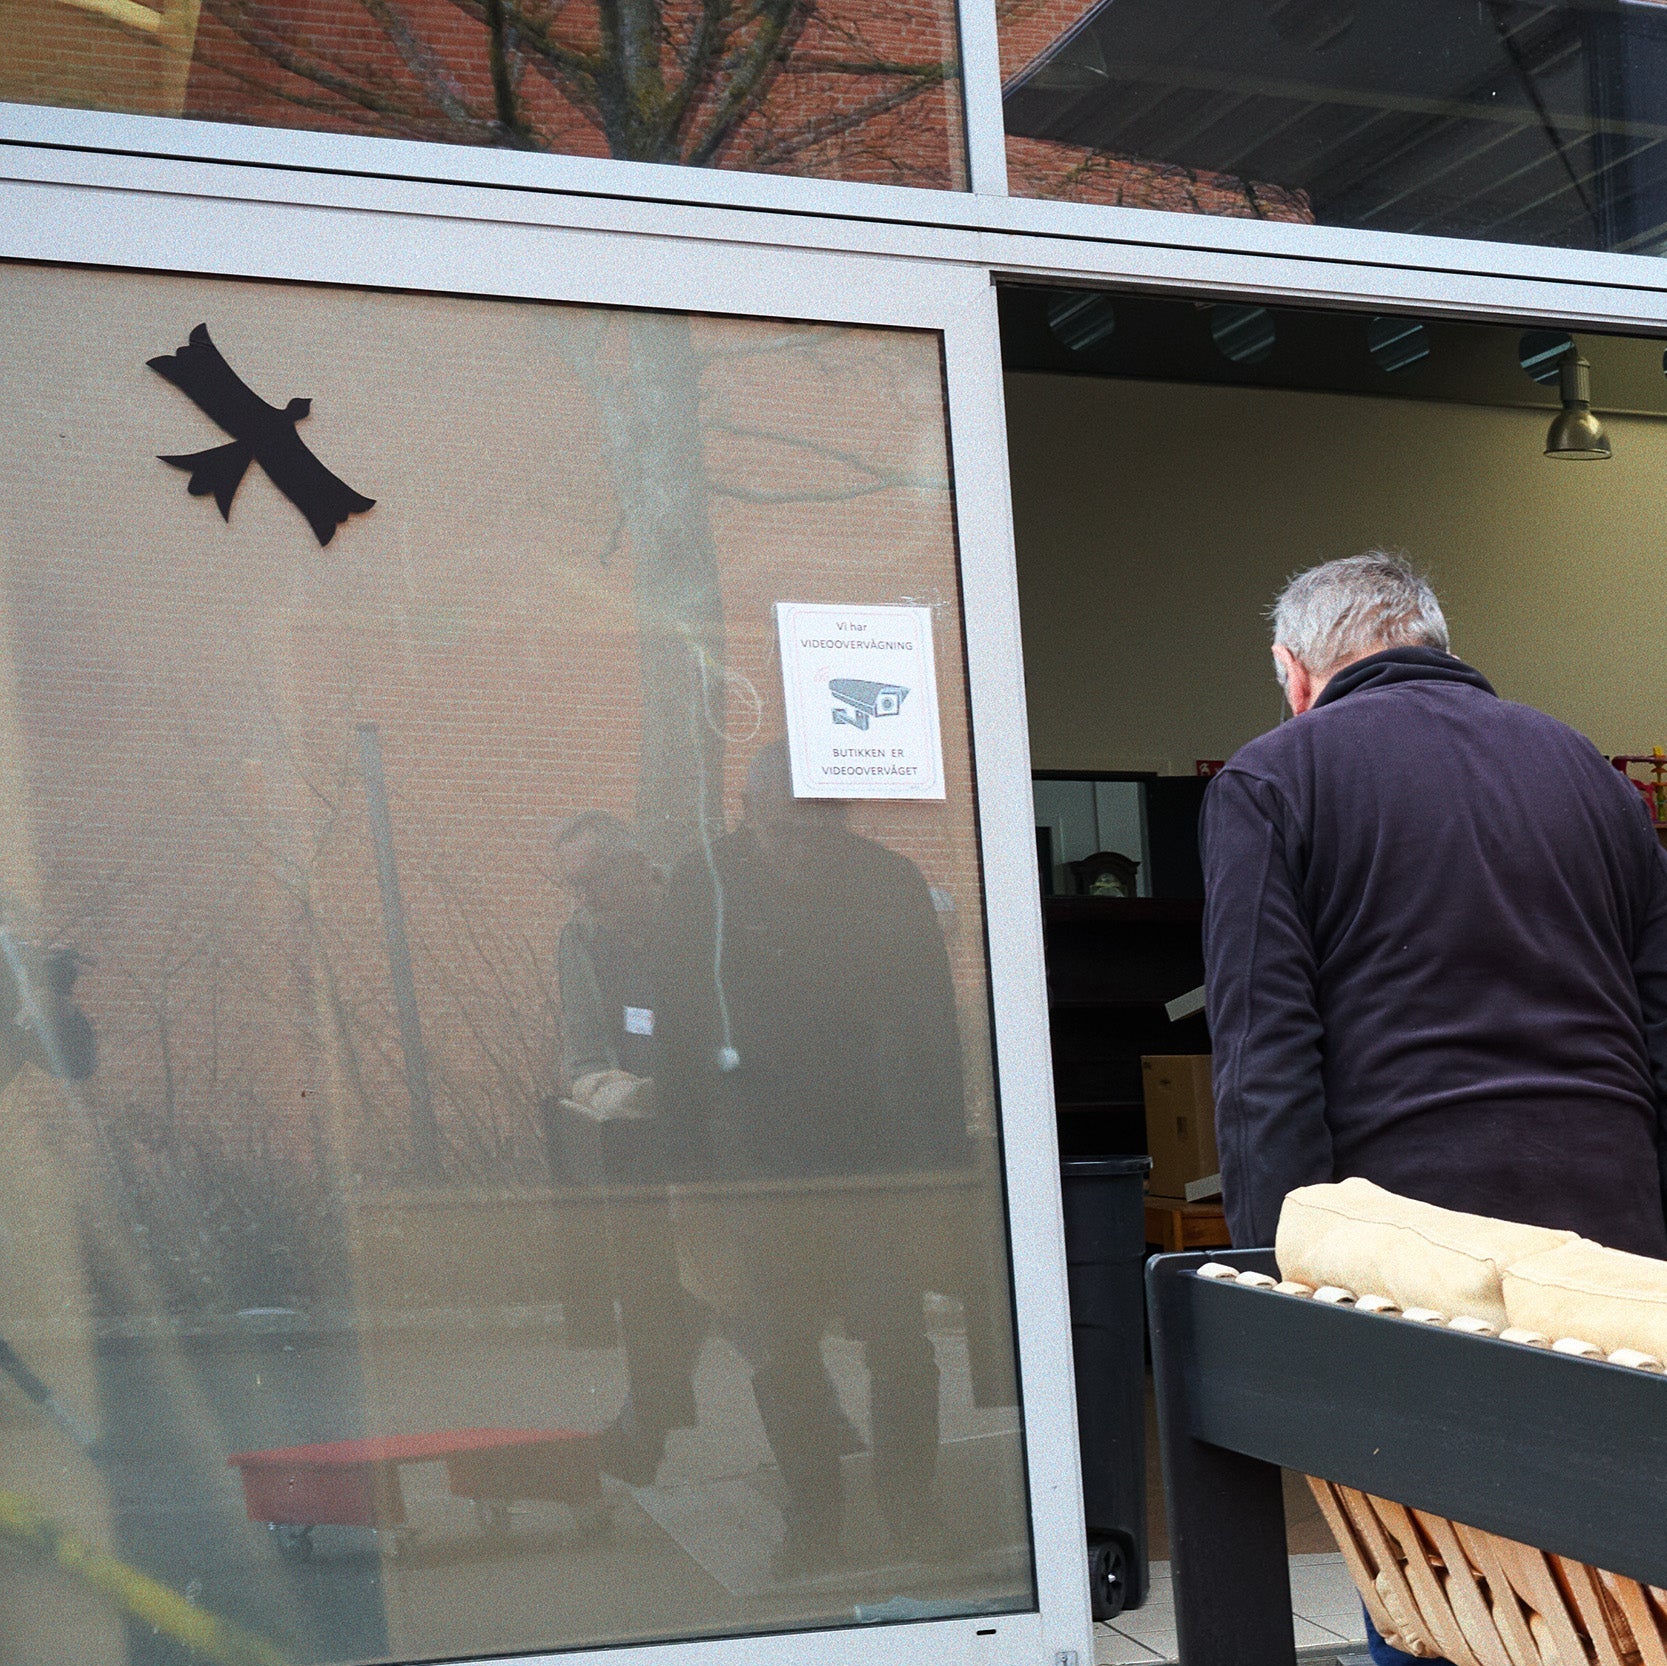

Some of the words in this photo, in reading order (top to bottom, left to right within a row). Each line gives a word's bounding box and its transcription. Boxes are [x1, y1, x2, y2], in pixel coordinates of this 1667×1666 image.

[836, 622, 848, 631] Vi
[850, 622, 868, 632] har
[800, 638, 913, 651] VIDEOOVERVÅGNING
[832, 748, 886, 758] BUTIKKEN
[891, 748, 904, 758] ER
[822, 765, 918, 776] VIDEOOVERVÅGET
